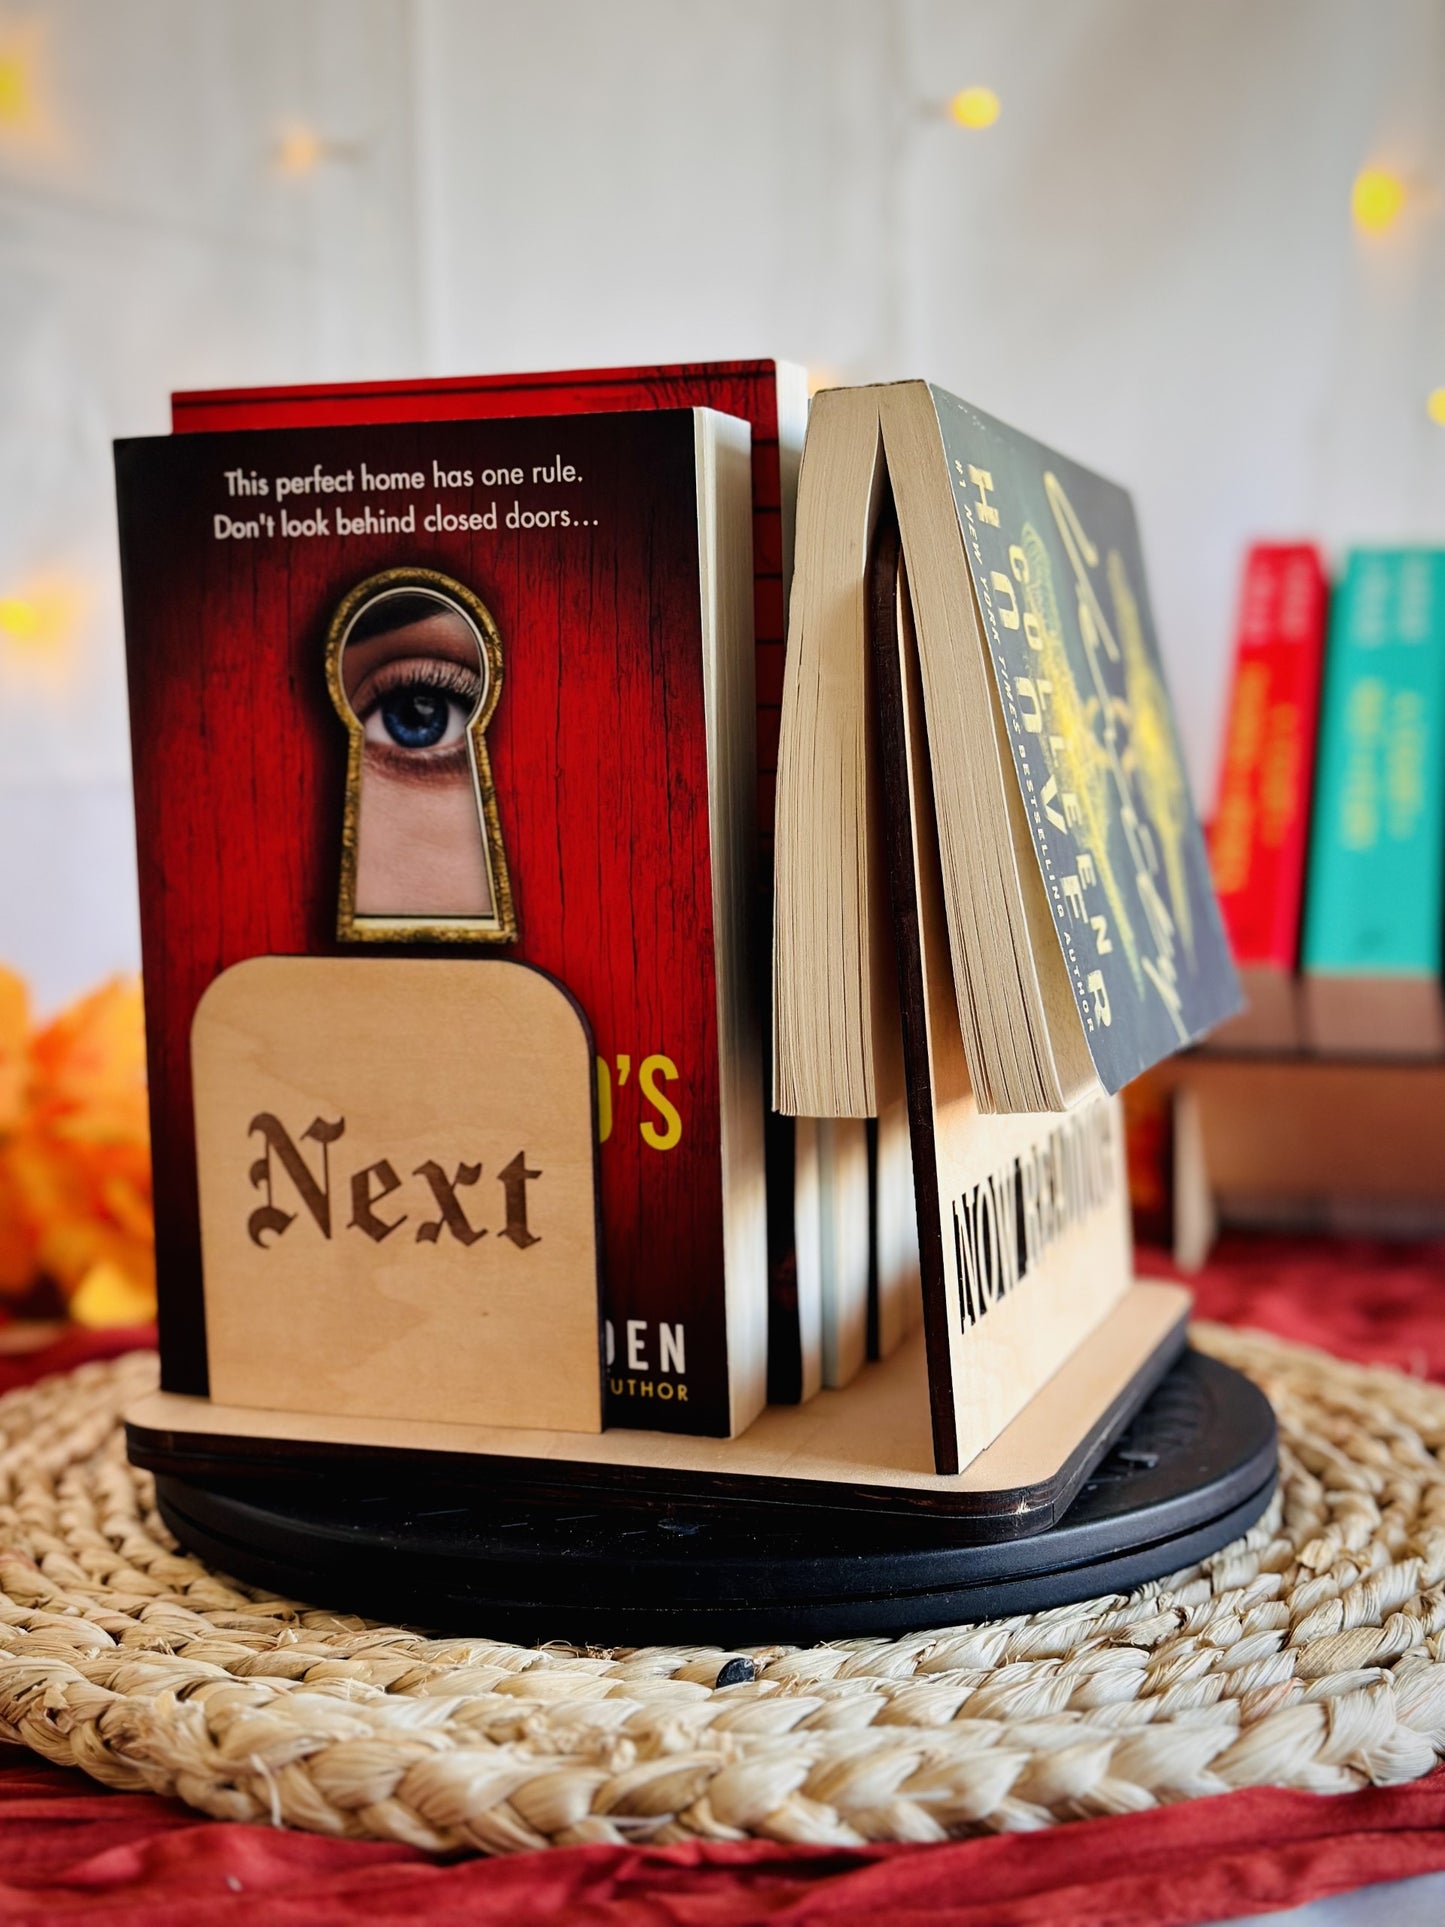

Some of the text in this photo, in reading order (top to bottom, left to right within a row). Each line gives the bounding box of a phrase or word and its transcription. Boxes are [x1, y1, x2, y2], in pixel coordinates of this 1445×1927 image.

[213, 501, 599, 540] Don't look behind closed doors...
[224, 454, 583, 502] This perfect home has one rule.
[955, 459, 1095, 1033] #1 NEW YORK TIMES BESTSELLING AUTHOR
[967, 463, 1112, 1028] HOOVER
[1009, 544, 1113, 956] COLLEEN
[247, 1111, 543, 1251] Next
[610, 1378, 688, 1402] UTHOR
